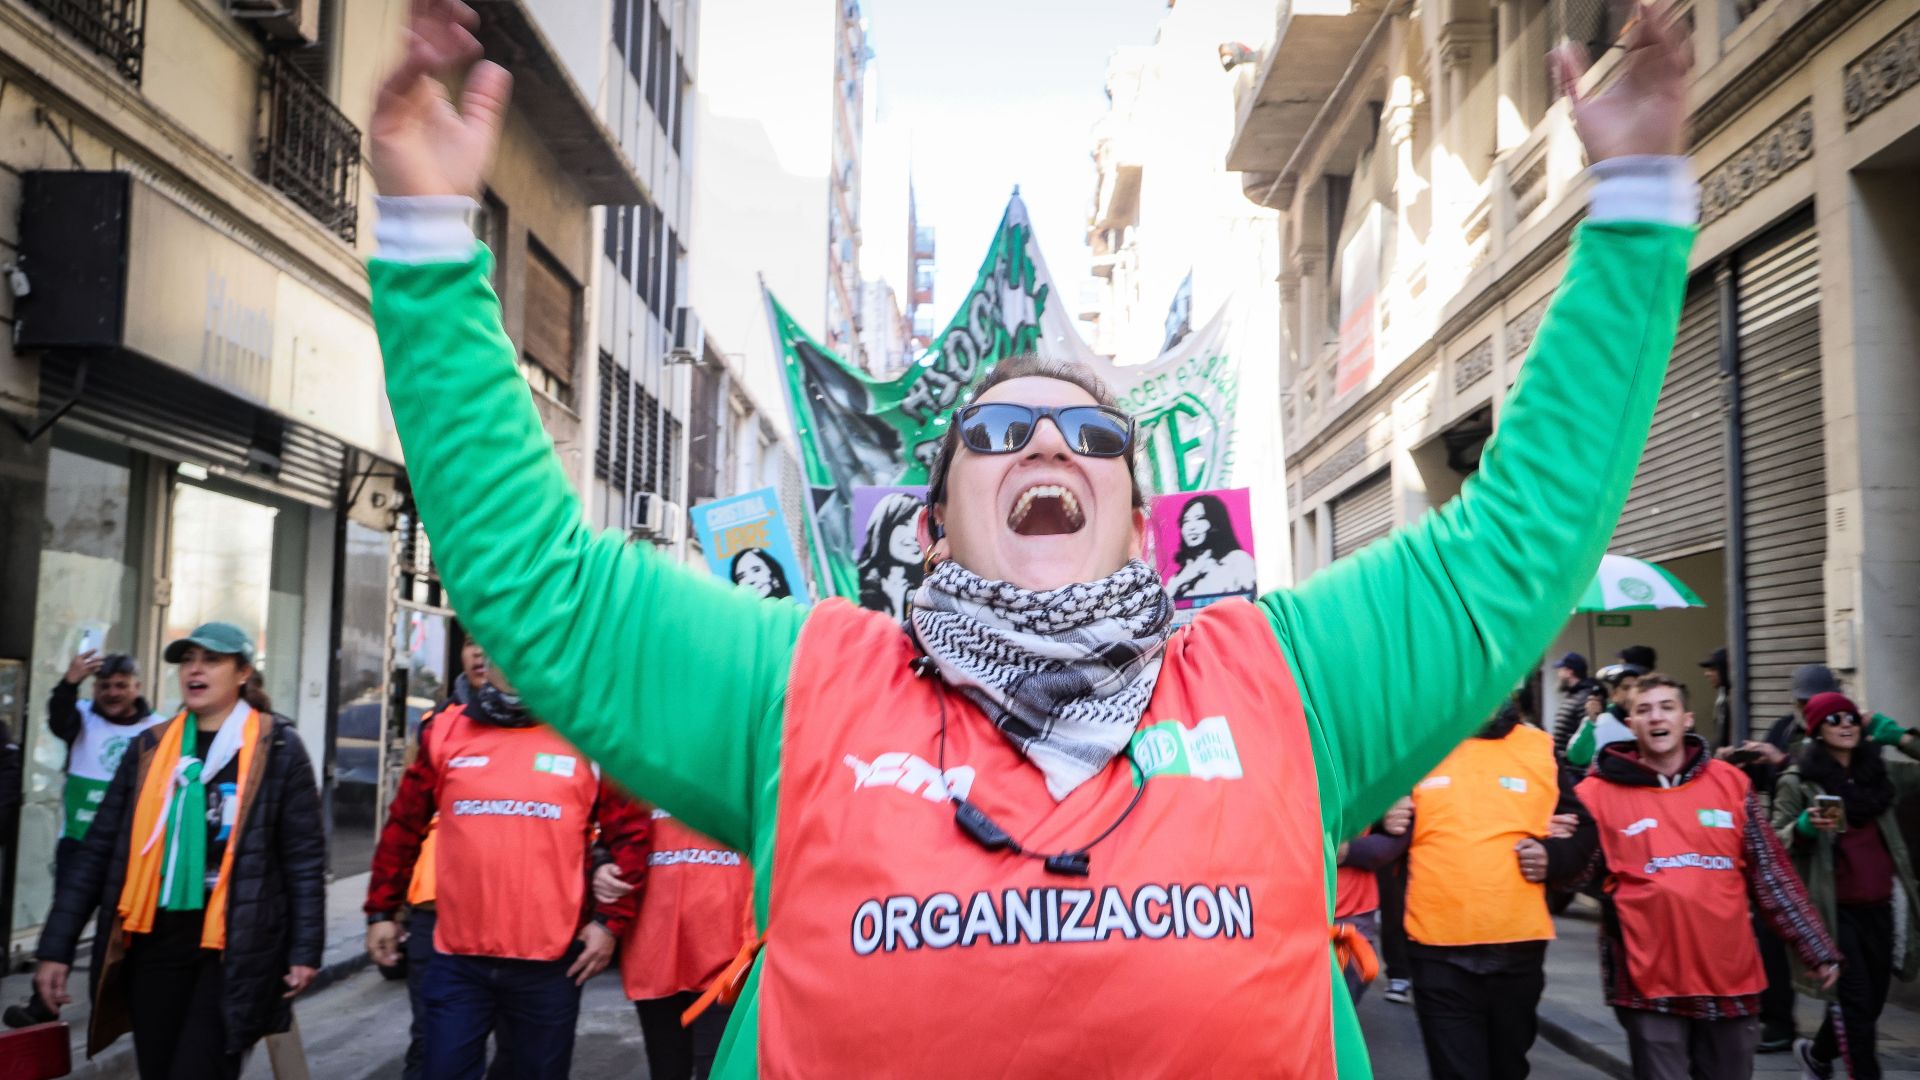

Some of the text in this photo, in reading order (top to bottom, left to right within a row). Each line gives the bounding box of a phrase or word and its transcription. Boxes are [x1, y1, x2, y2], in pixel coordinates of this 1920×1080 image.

[1138, 402, 1207, 492] TE
[452, 799, 562, 820] ORGANIZACION
[851, 883, 1254, 955] ORGANIZACION
